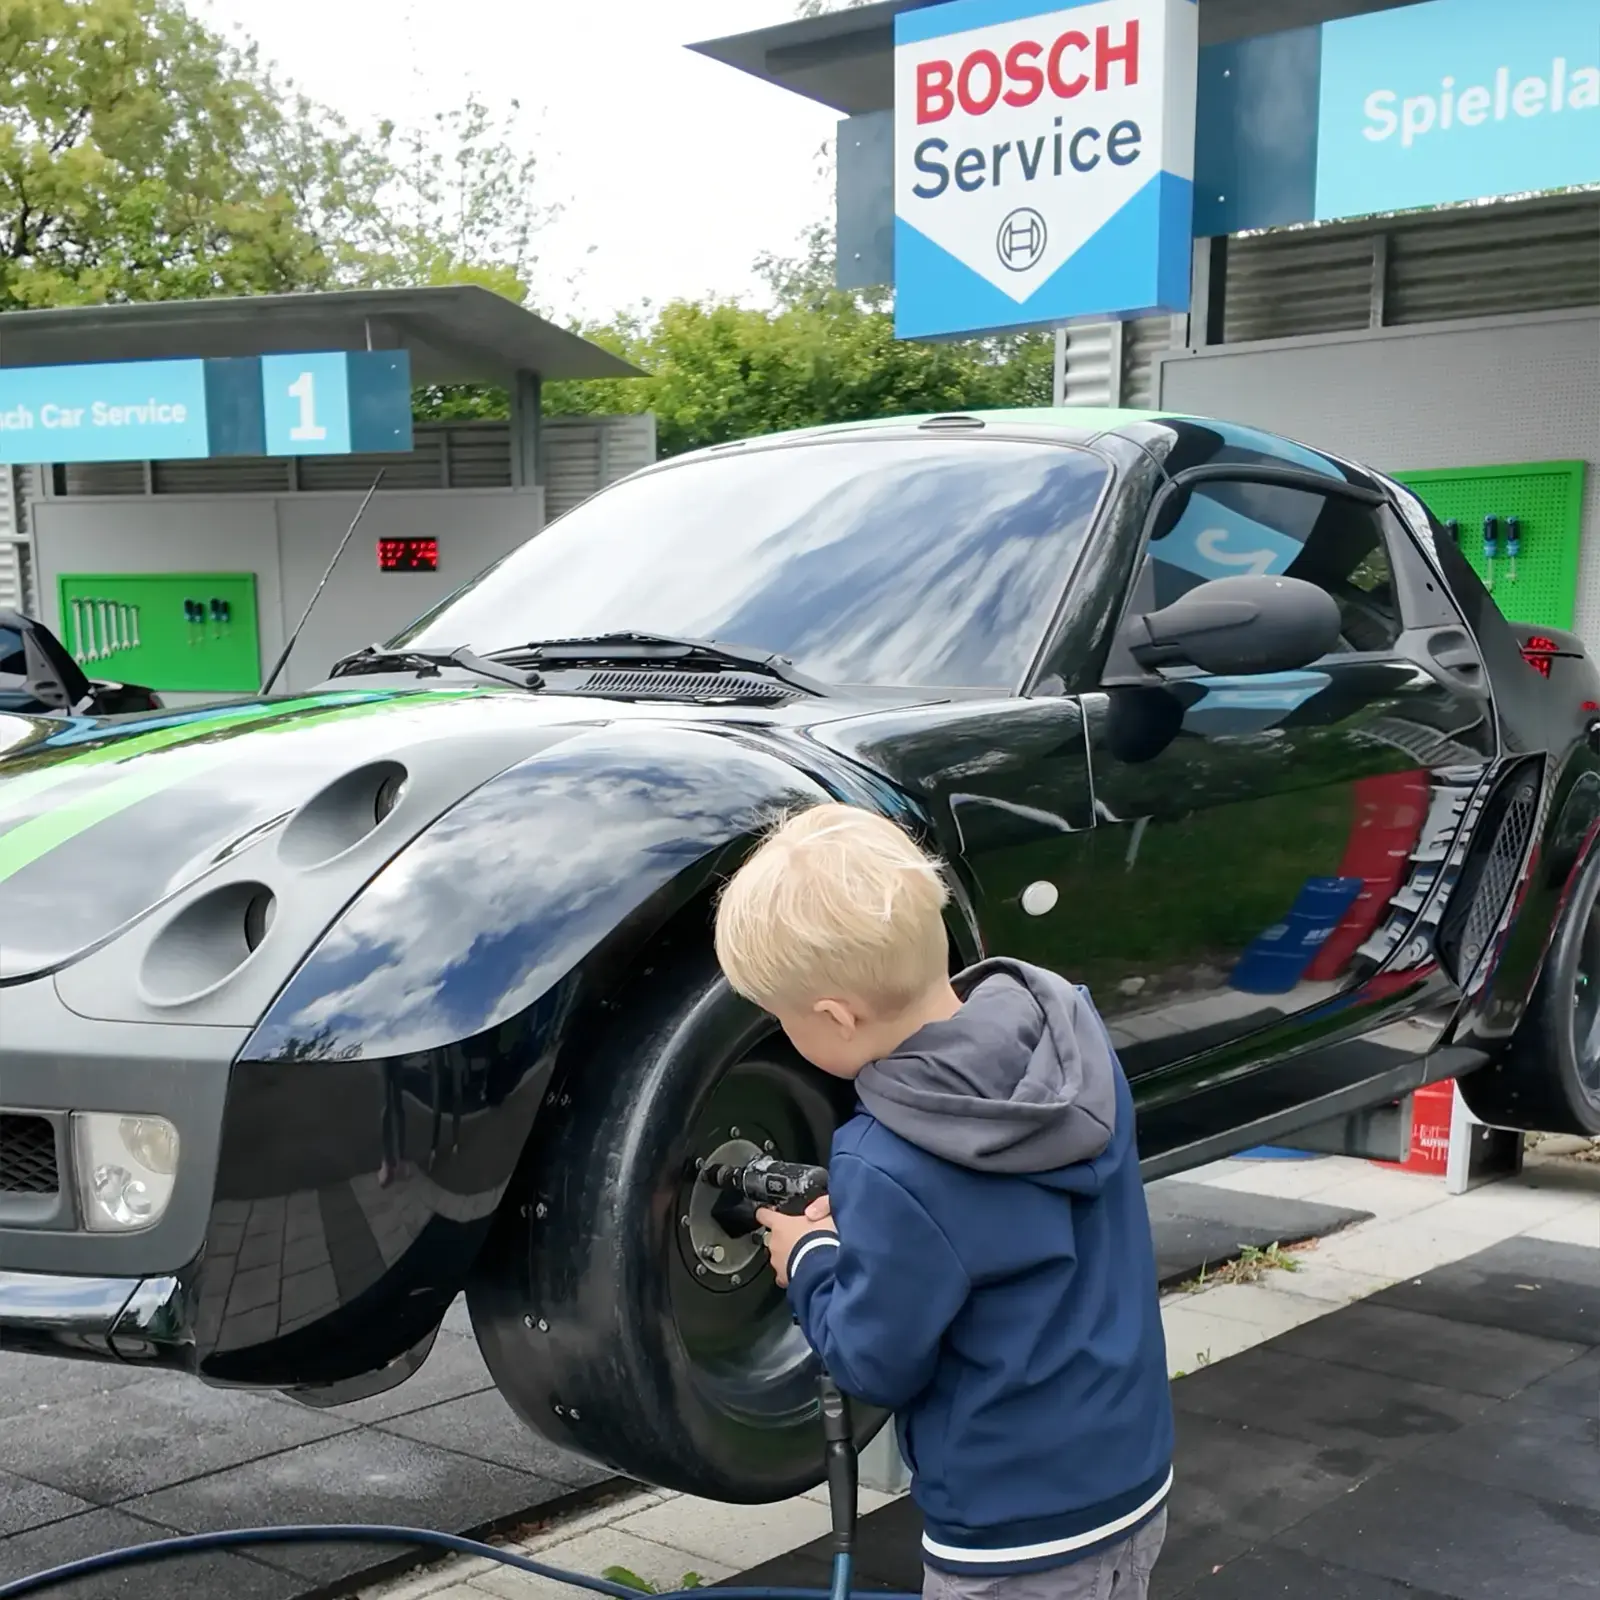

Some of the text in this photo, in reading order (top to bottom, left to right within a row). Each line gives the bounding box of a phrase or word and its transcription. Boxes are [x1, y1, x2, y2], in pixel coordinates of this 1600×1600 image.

[916, 19, 1140, 126] BOSCH
[1361, 56, 1600, 149] Spielela
[911, 116, 1142, 199] Service
[40, 403, 85, 429] Car
[91, 397, 187, 427] Service
[287, 371, 327, 441] 1
